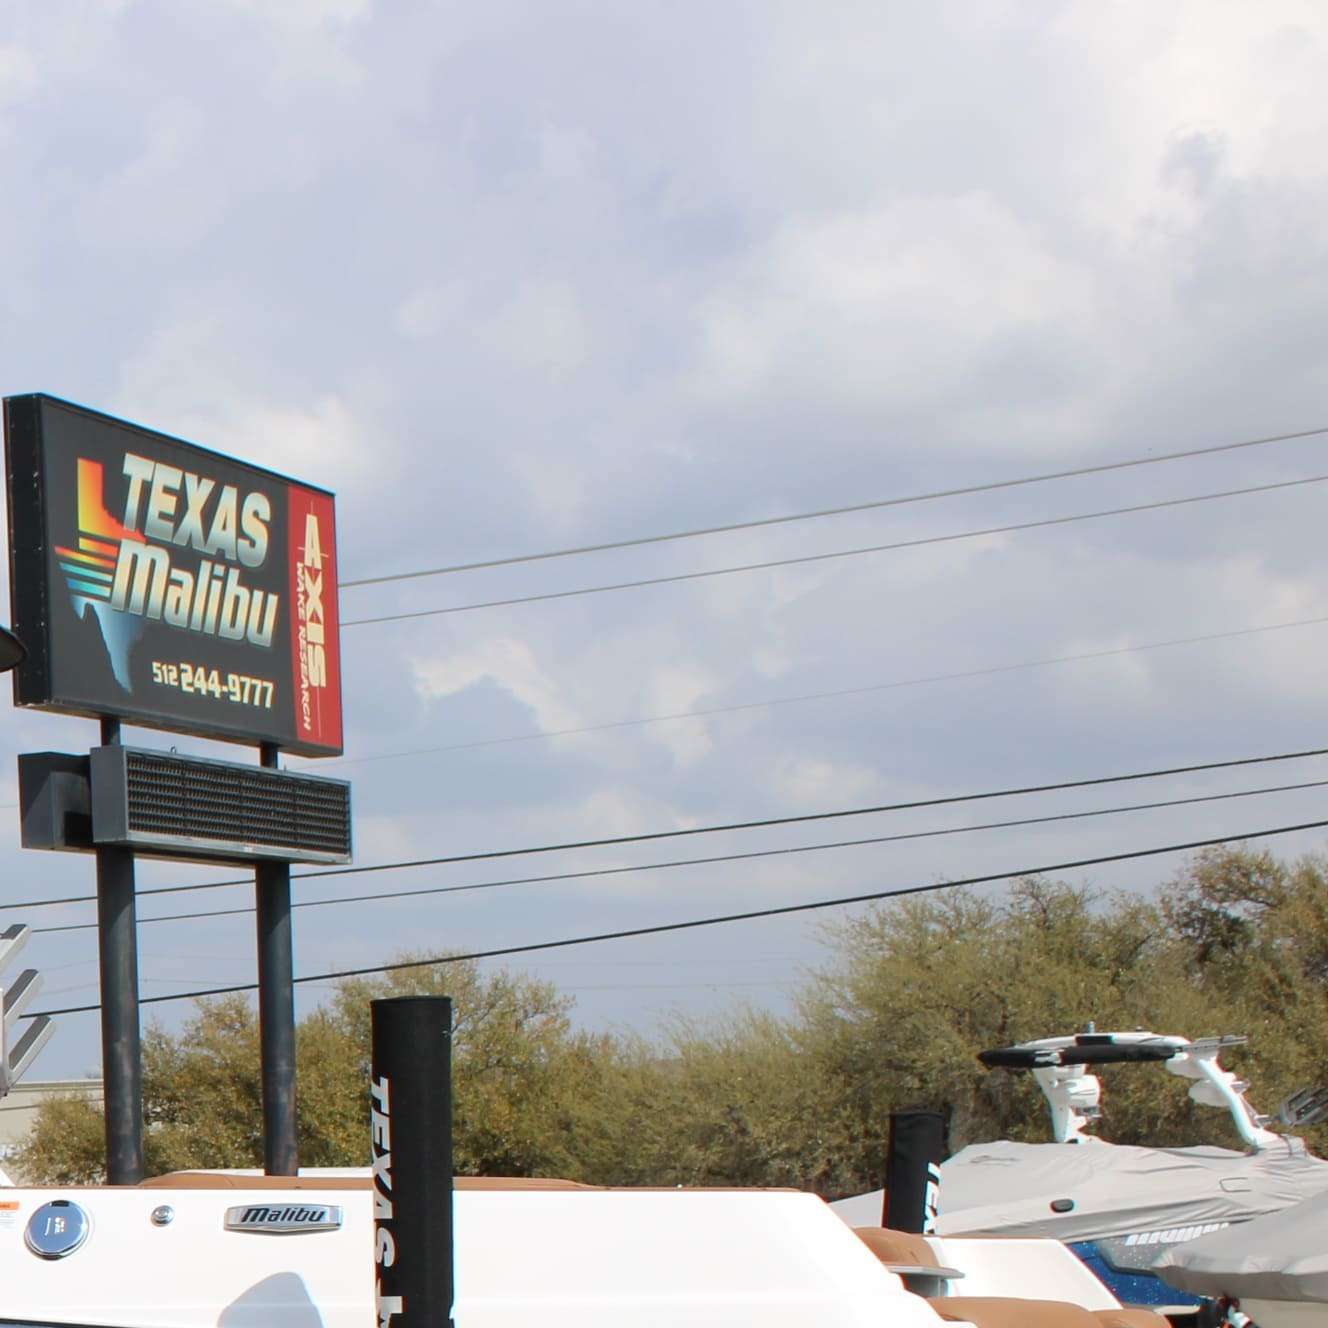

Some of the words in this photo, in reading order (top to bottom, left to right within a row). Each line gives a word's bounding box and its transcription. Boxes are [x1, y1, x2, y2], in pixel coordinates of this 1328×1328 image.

[122, 452, 272, 568] TEXAS
[110, 538, 279, 648] Malibu
[297, 561, 306, 622] WAKE
[304, 514, 326, 688] AXIS
[151, 661, 178, 686] 512
[179, 663, 274, 708] 244-9777
[298, 625, 311, 731] RESEARCH
[240, 1207, 326, 1222] Malibu
